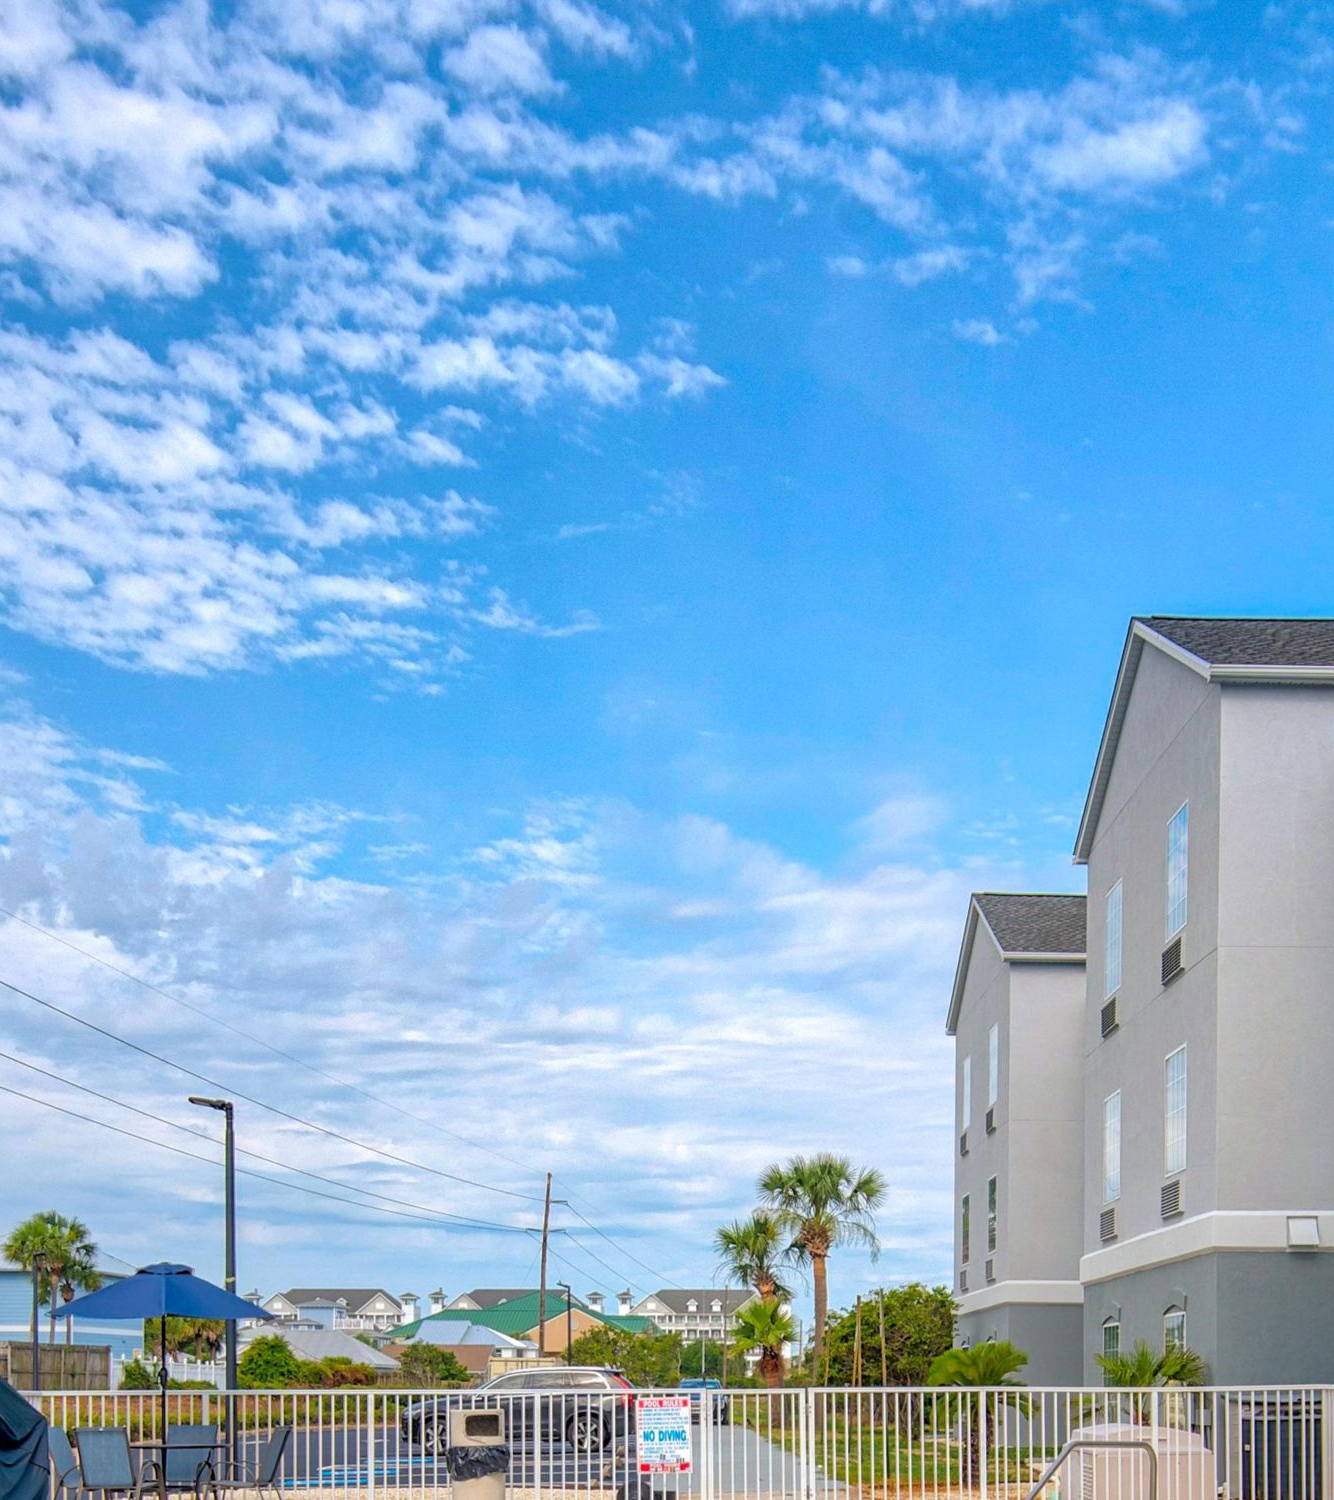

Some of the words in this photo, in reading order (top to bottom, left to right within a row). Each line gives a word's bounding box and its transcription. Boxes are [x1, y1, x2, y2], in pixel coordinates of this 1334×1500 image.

[643, 1399, 661, 1408] POOL
[643, 1430, 655, 1442] NO
[658, 1430, 687, 1442] DIVING
